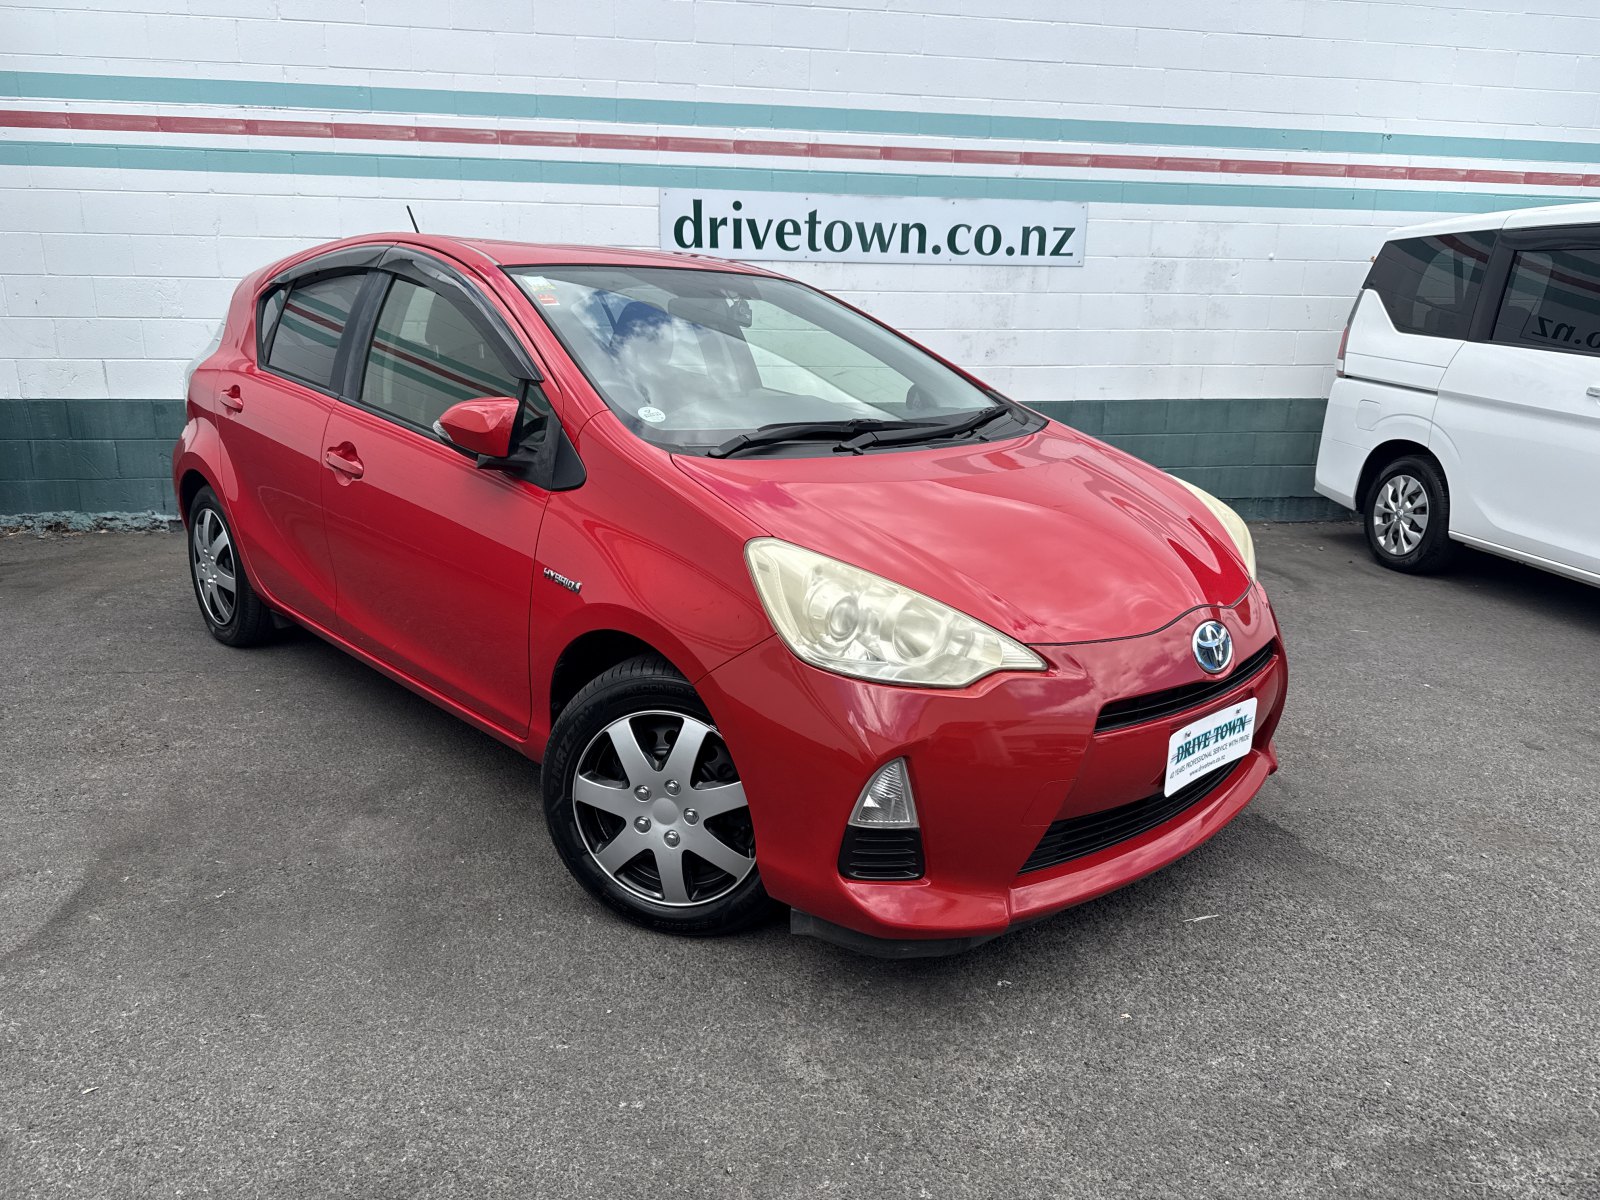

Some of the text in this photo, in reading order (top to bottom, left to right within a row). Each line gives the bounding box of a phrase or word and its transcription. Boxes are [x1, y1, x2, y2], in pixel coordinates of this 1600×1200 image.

[673, 198, 1077, 257] drivetown.co.nz
[1174, 765, 1186, 776] YEARS
[1185, 752, 1213, 769] PROFESSIONAL
[1212, 744, 1228, 756] SERVICE
[1228, 739, 1238, 748] WITH
[1238, 733, 1250, 743] PRIDE
[1175, 715, 1247, 765] DRIVE TOWN
[1189, 755, 1226, 776] www.drivetown.co.nz
